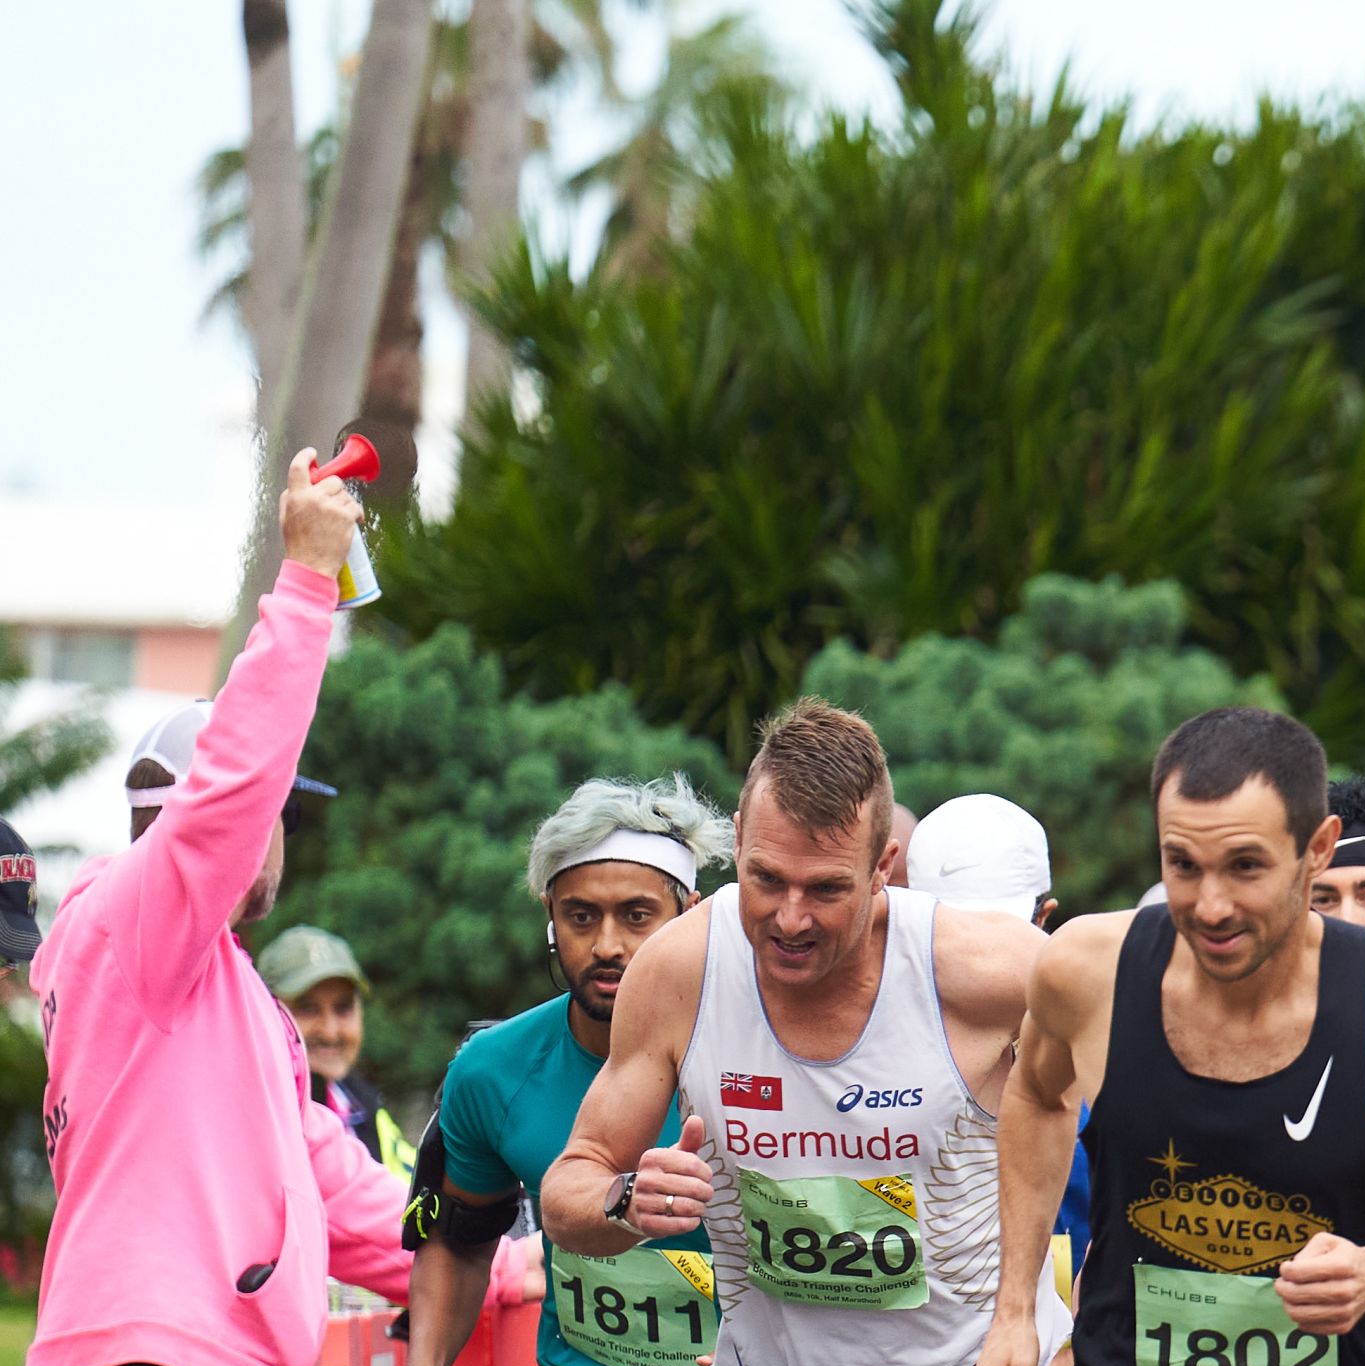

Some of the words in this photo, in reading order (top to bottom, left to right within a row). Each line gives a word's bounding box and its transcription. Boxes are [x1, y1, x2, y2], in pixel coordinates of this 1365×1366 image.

[864, 1087, 923, 1108] asics
[725, 1119, 920, 1161] Bermuda
[749, 1184, 808, 1209] CHUBB
[874, 1181, 902, 1205] Wave
[902, 1201, 912, 1210] 2
[1178, 1187, 1283, 1208] ELITE
[1160, 1210, 1208, 1237] LAS
[1215, 1219, 1309, 1244] VEGAS
[751, 1219, 916, 1278] 1820
[1206, 1243, 1254, 1256] GOLD
[677, 1255, 701, 1284] Wave
[700, 1282, 710, 1292] 2
[753, 1263, 798, 1288] Bermuda
[800, 1280, 852, 1293] Triangle
[855, 1278, 917, 1294] Challenge
[1147, 1284, 1217, 1304] CHUBB
[561, 1276, 703, 1344] 1811
[564, 1325, 606, 1348] Bermuda
[608, 1341, 650, 1359] Triangle
[653, 1351, 702, 1361] Challen
